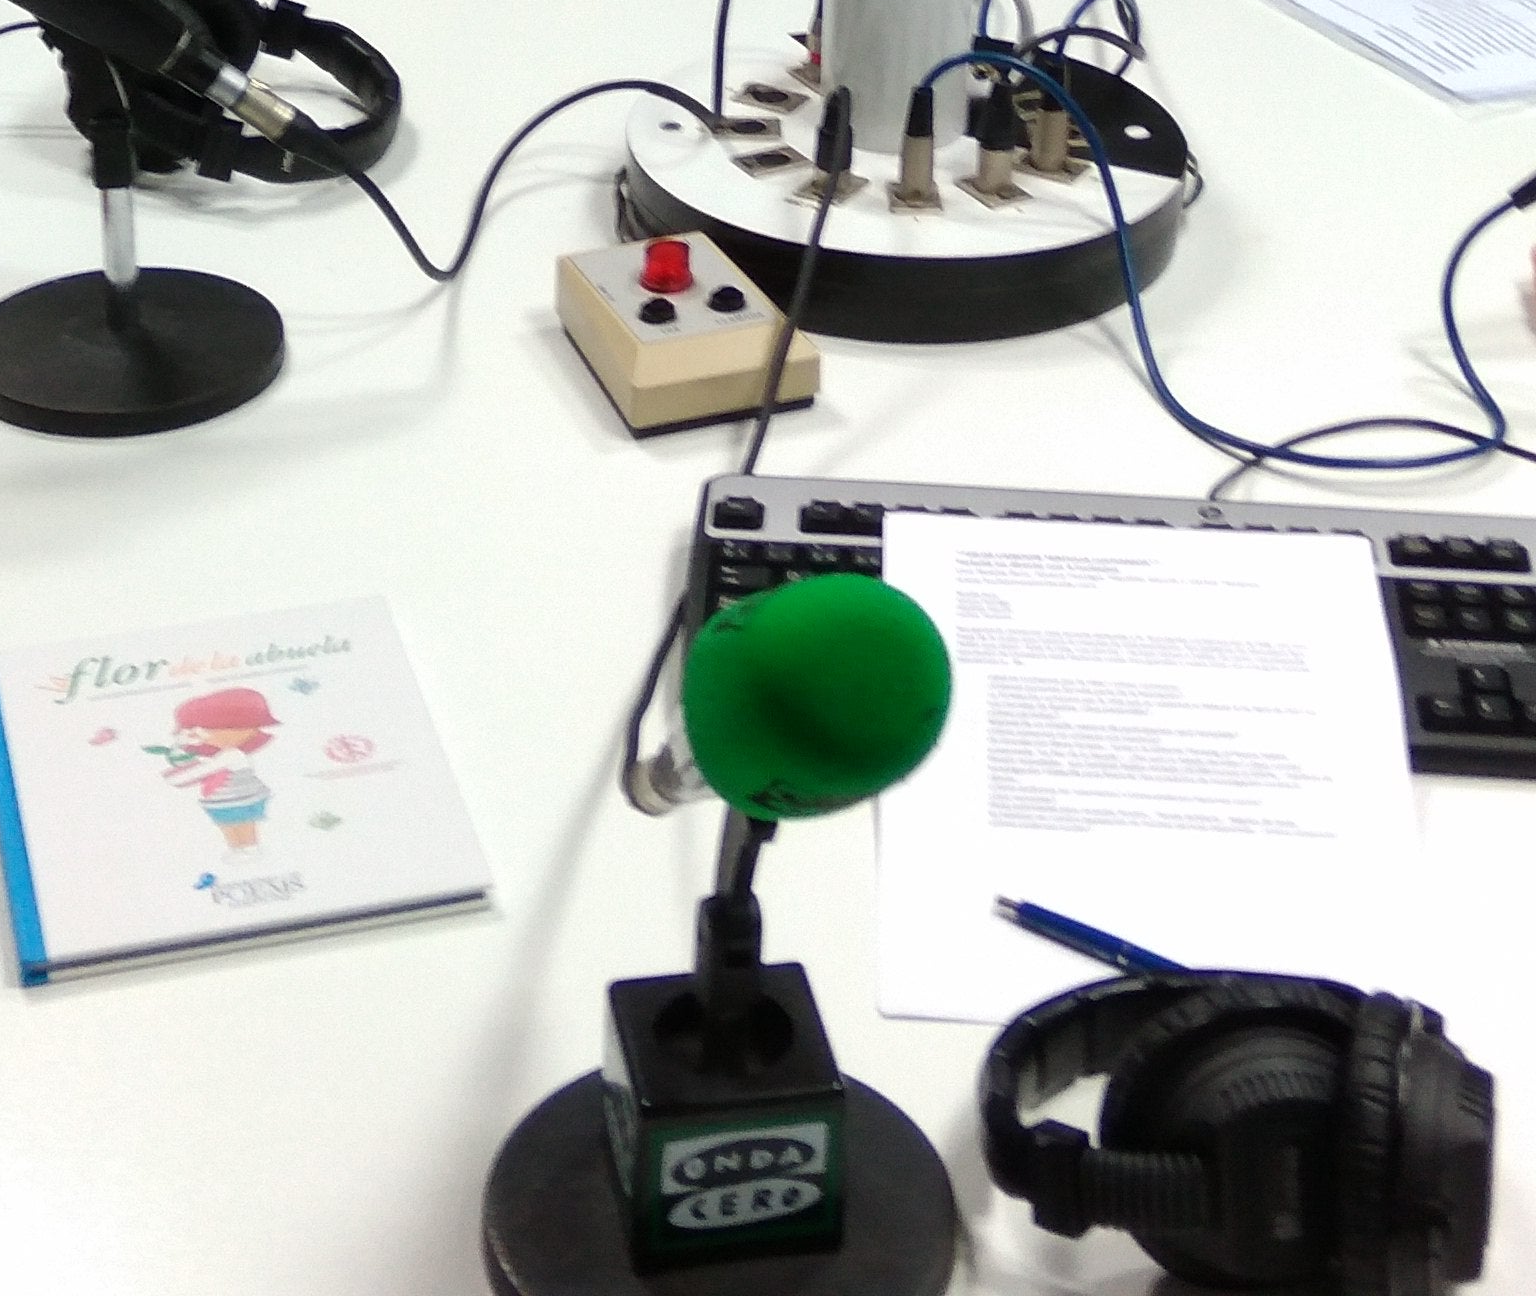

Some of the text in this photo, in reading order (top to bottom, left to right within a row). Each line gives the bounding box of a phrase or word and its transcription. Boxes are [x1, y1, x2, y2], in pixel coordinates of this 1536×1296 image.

[53, 655, 169, 705] flor
[244, 634, 352, 667] abuela
[682, 1146, 806, 1181] ONDA
[688, 1186, 802, 1221] CERO
